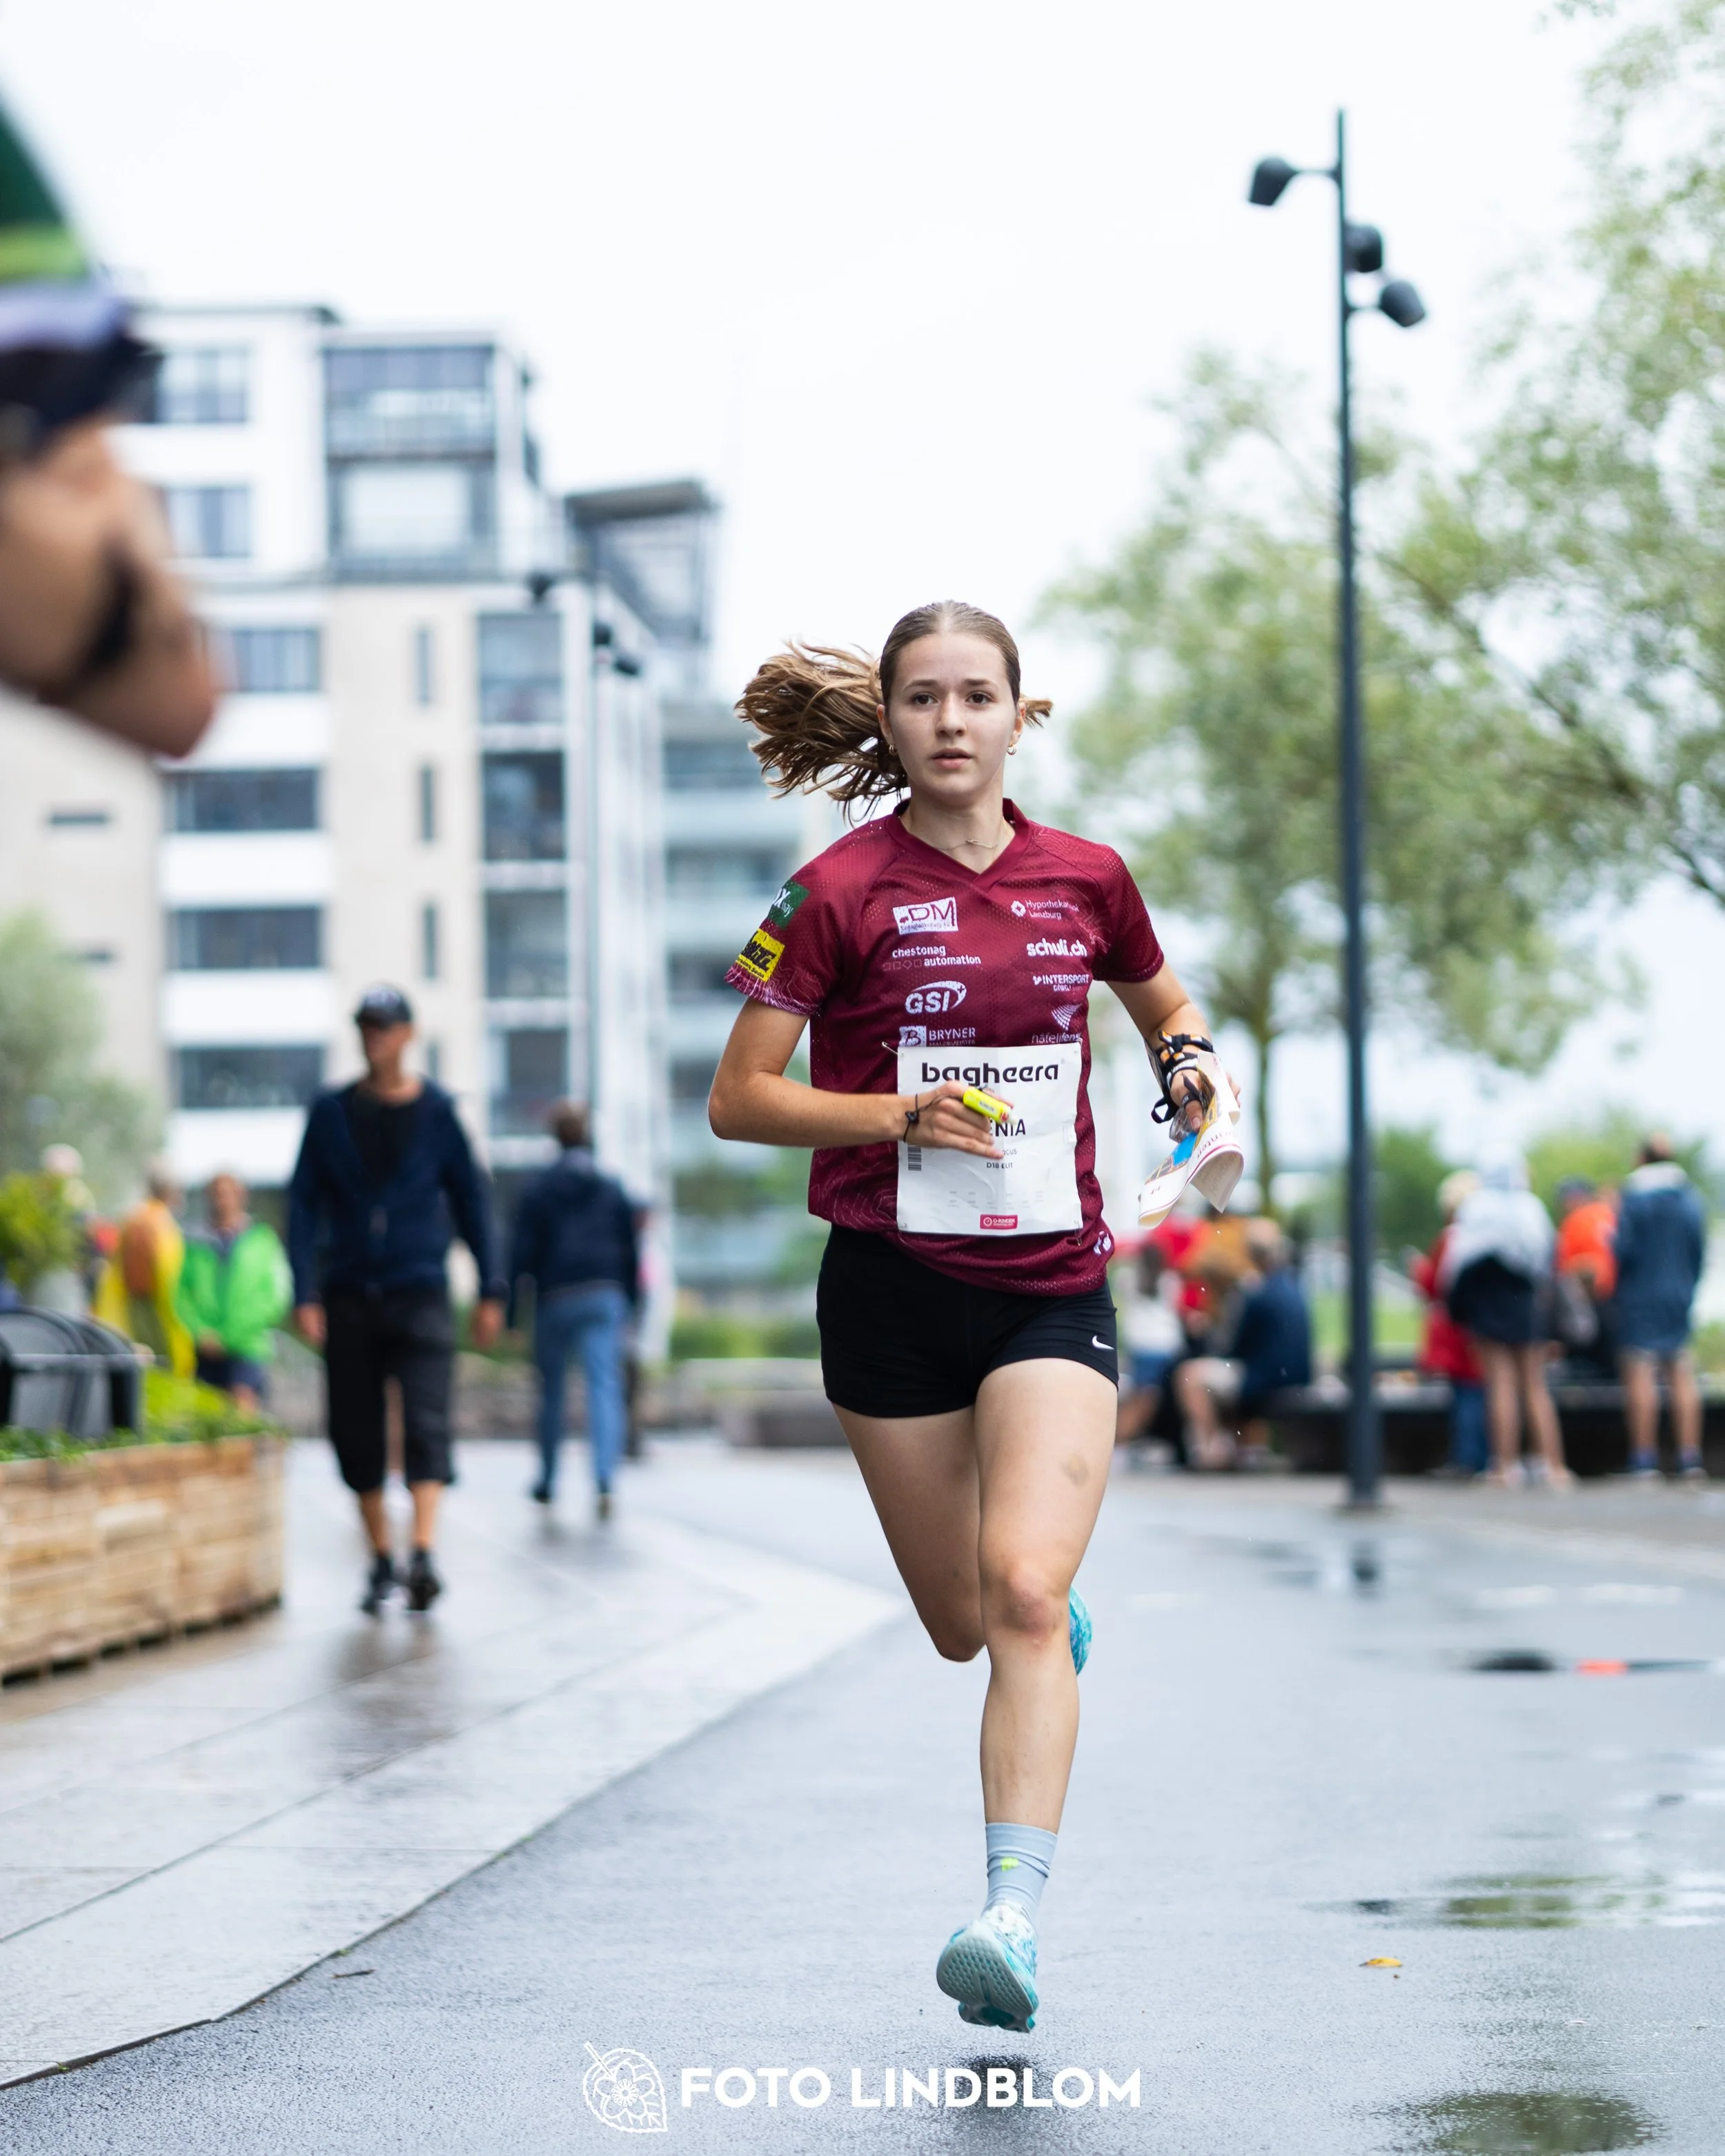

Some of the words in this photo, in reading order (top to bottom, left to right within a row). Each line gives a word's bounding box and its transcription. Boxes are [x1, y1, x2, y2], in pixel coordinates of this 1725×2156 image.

[1028, 909, 1062, 921] Lenzburg
[891, 945, 947, 959] chestonag
[1026, 938, 1087, 957] schuli.ch
[924, 955, 982, 967] automation
[1042, 973, 1090, 985] INTERSPORT
[905, 990, 950, 1014] GSI
[929, 1027, 976, 1040] BRYNER
[922, 1062, 1059, 1087] bagheera
[989, 1118, 1026, 1137] NIA
